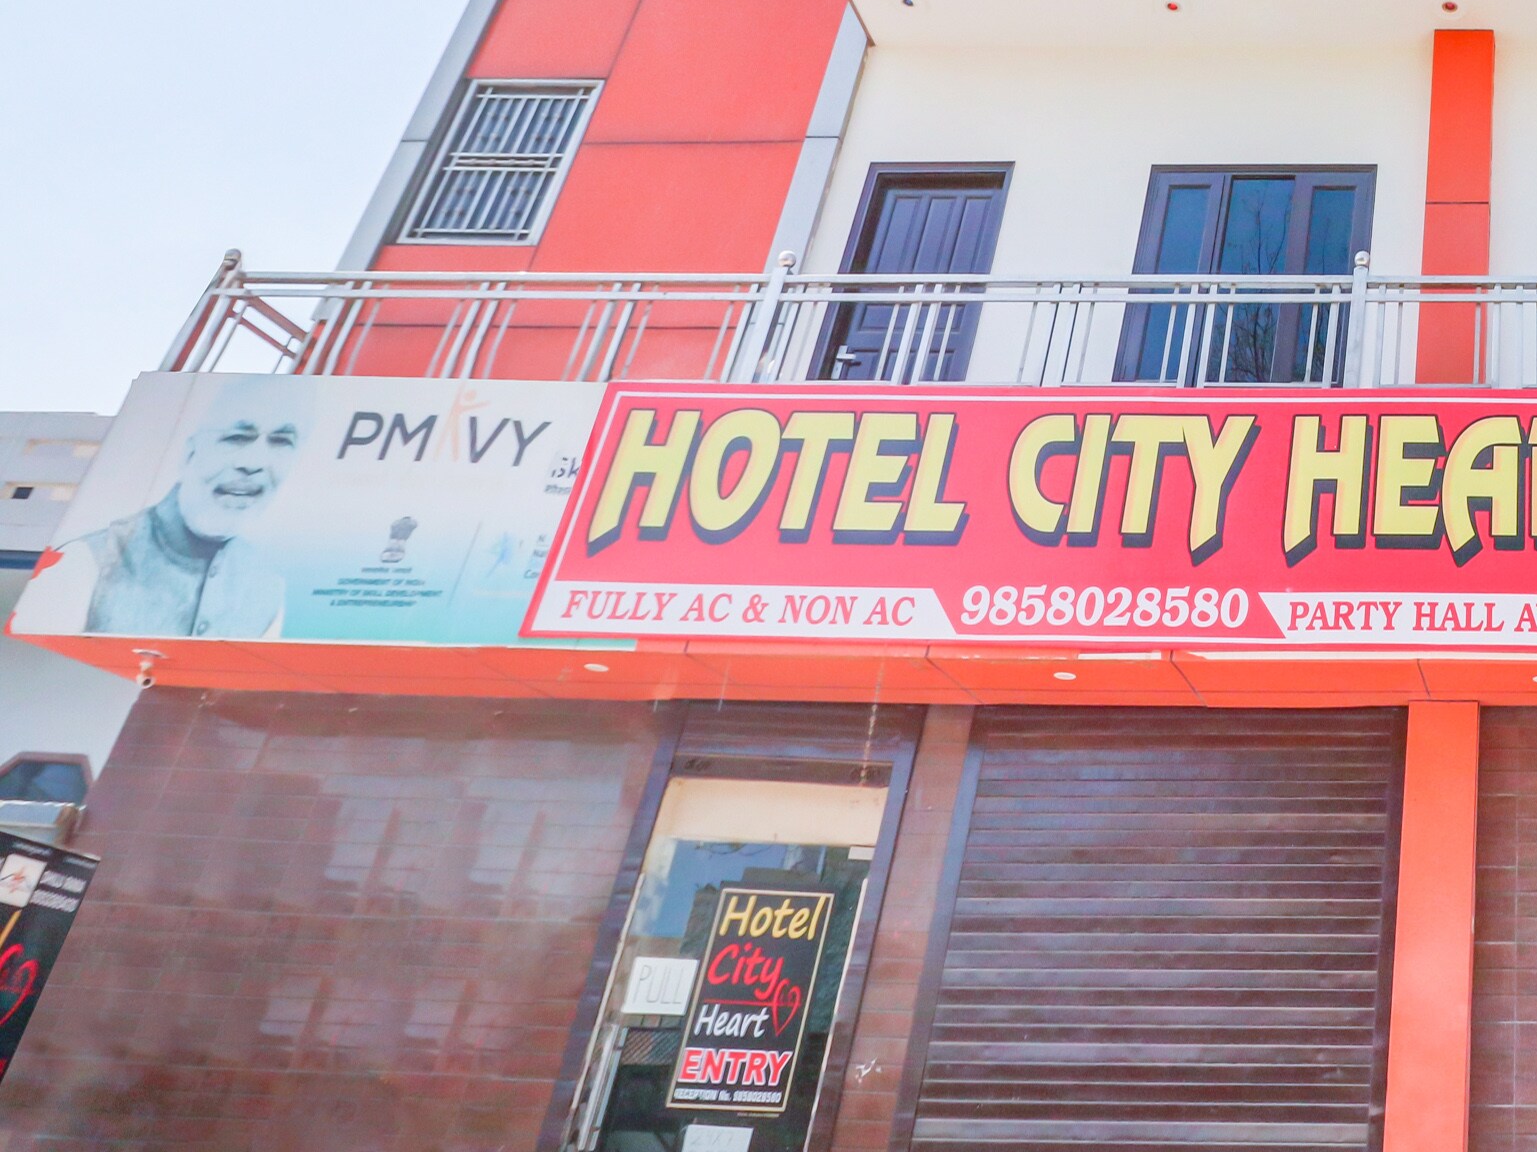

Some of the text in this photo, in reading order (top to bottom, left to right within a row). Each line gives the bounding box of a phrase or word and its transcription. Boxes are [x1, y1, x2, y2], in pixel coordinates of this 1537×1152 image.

[586, 407, 968, 557] HOTEL
[1008, 412, 1262, 567] CITY
[561, 589, 680, 621] FULLY
[680, 593, 733, 622] AC
[741, 595, 767, 624] &
[777, 595, 860, 626] NON
[864, 596, 916, 626] AC
[960, 584, 1249, 628] 9858028580
[1288, 600, 1403, 633] PARTY
[1413, 601, 1505, 633] HALL
[719, 895, 827, 940] Hotel
[633, 964, 685, 1005] PULL
[706, 941, 784, 1000] City
[694, 1004, 770, 1039] Heart
[677, 1047, 793, 1086] ENTRY
